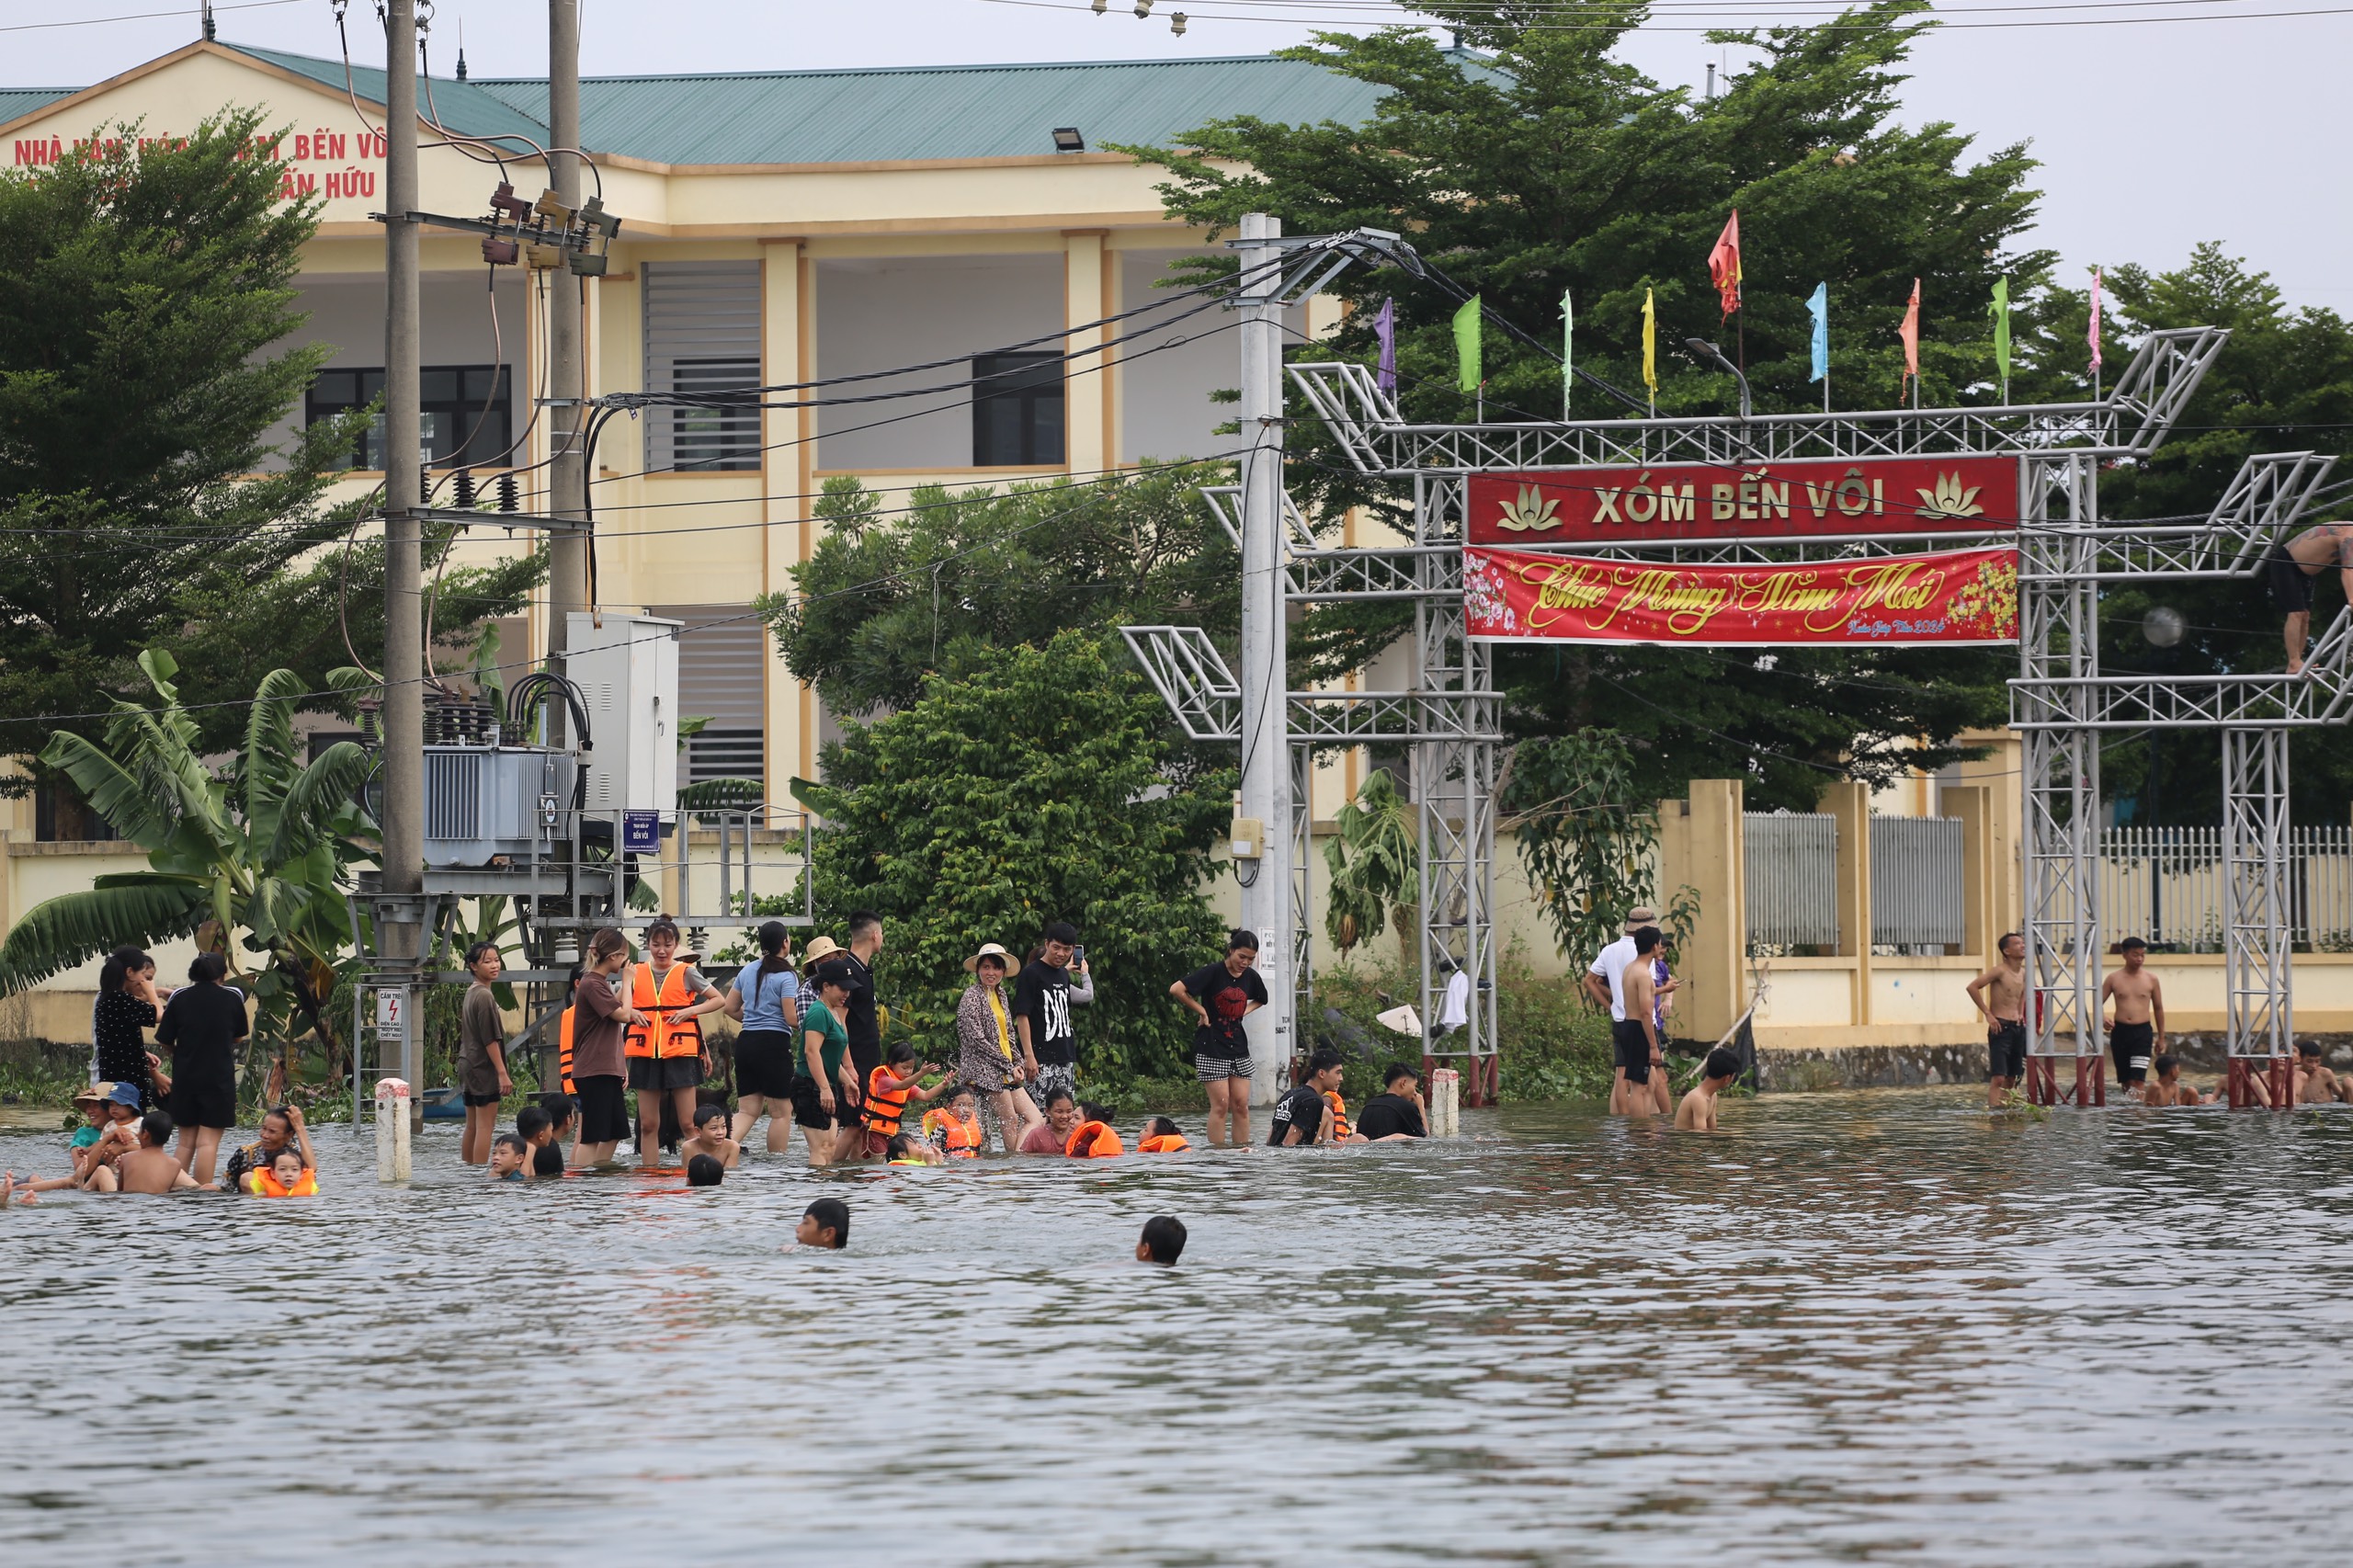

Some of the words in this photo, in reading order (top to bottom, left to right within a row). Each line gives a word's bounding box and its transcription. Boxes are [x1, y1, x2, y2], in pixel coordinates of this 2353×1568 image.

[15, 134, 63, 165] NHÀ
[295, 128, 346, 160] BẾN
[325, 165, 375, 199] HỮU
[1592, 471, 1695, 523] XÓM
[1711, 467, 1790, 520] BẾN
[1805, 467, 1884, 517] VÔI
[1519, 562, 1613, 629] Chúc
[1584, 566, 1737, 634] Mừng
[1738, 570, 1848, 613] Năm
[1804, 562, 1946, 632] Mới
[1914, 618, 1946, 633] 2024
